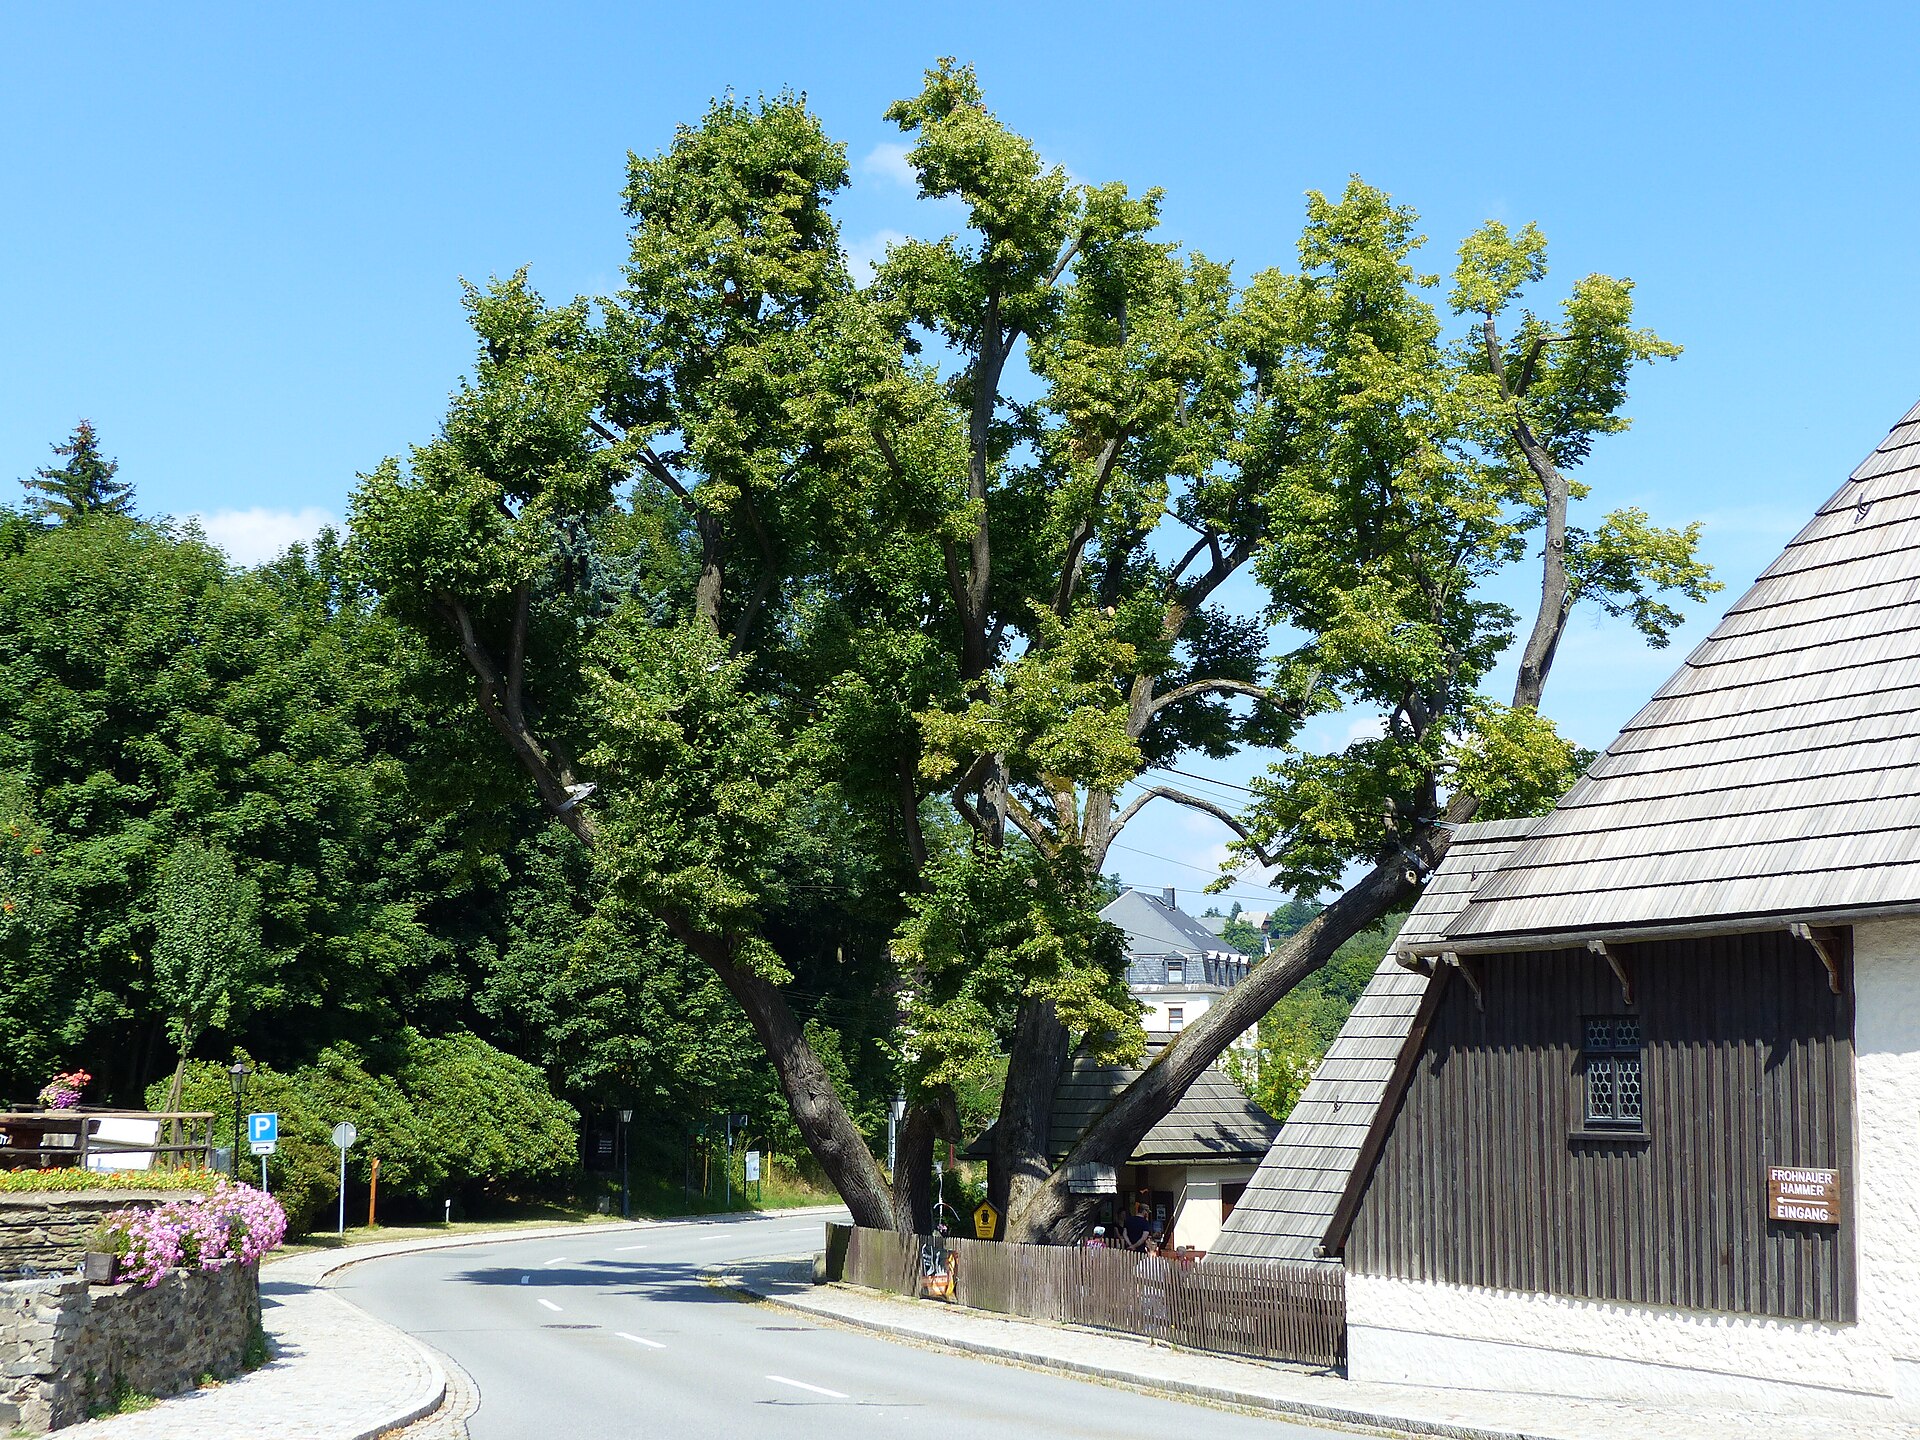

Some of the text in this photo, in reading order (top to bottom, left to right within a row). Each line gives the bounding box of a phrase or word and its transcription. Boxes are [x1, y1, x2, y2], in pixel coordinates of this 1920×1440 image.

[255, 1117, 271, 1138] P
[1771, 1170, 1833, 1184] FROHNAUER
[1780, 1183, 1824, 1196] HAMMER
[1777, 1205, 1829, 1220] EINGANG
